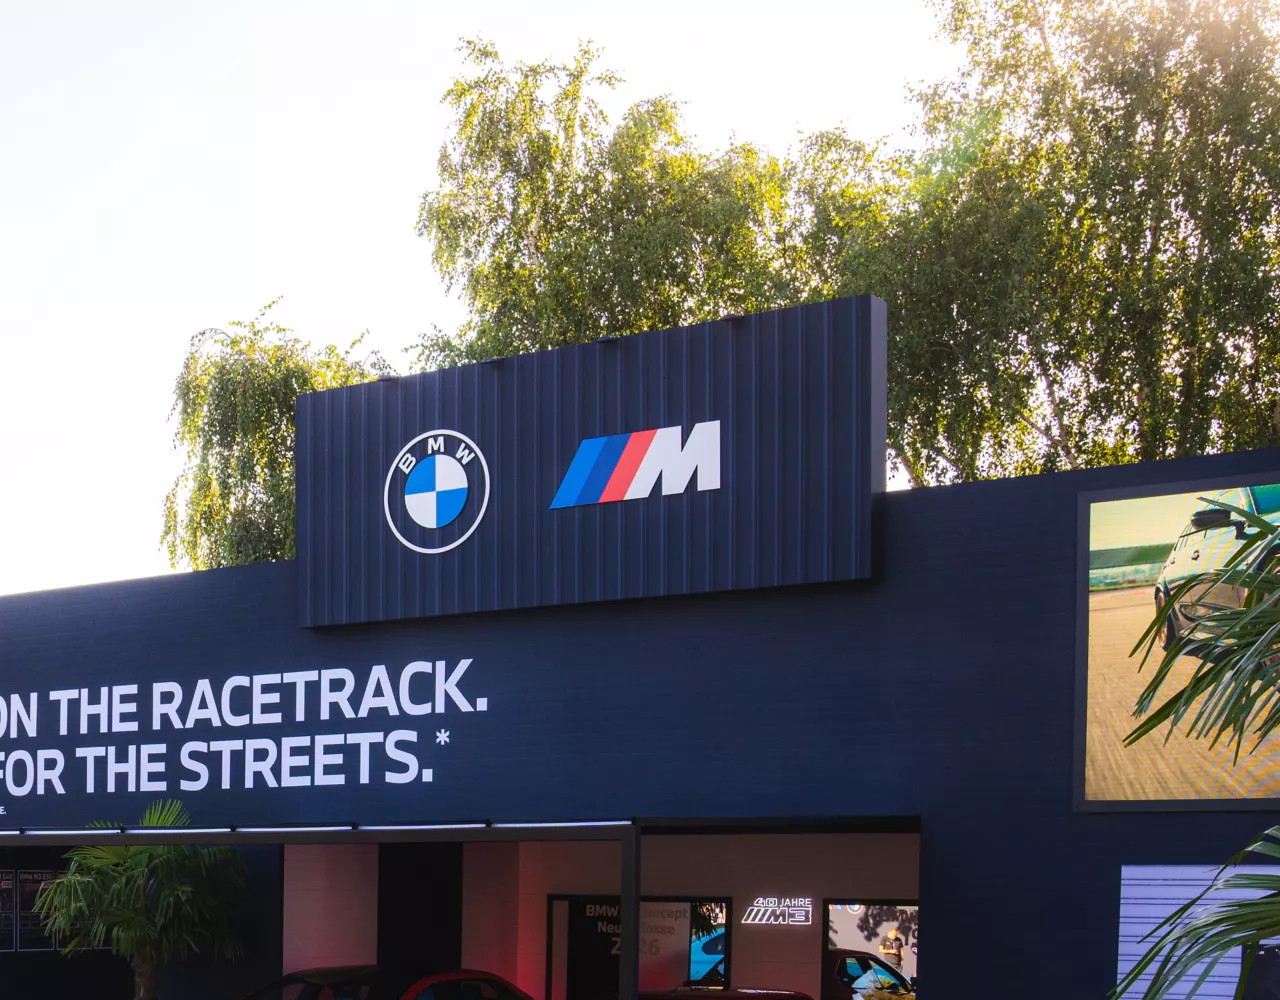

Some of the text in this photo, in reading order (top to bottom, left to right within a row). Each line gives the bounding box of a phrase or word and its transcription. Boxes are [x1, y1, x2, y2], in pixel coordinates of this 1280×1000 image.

[398, 436, 475, 474] BMW
[49, 684, 139, 736] THE
[153, 659, 488, 731] RACETRACK.
[76, 744, 167, 794] THE
[585, 904, 619, 917] BMW
[779, 897, 812, 908] JAHRE
[597, 920, 622, 933] Neu
[610, 936, 660, 956] 226
